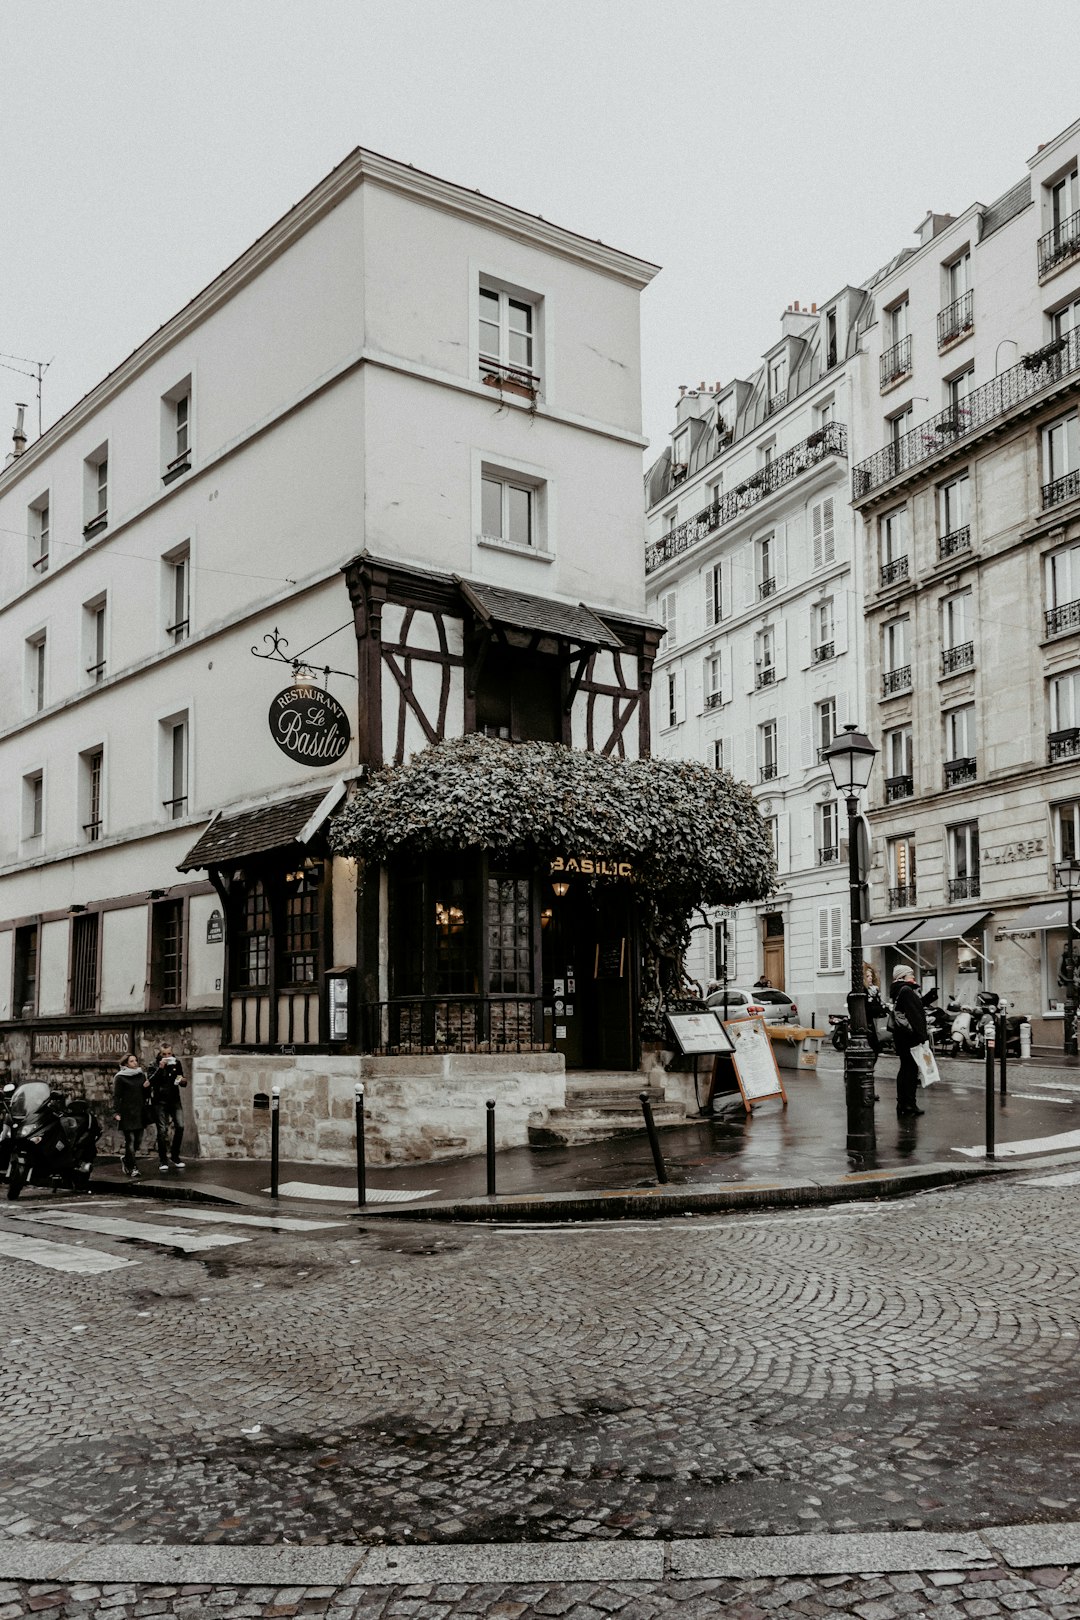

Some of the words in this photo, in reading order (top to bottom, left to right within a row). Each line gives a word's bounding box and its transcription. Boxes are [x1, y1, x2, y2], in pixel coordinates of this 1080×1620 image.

[277, 688, 344, 719] RESTAURANT
[306, 707, 325, 726] Le
[276, 709, 346, 758] Basilic
[550, 857, 632, 876] BASILIC
[34, 1034, 68, 1053] AUBERGE
[103, 1033, 129, 1053] LOGIS
